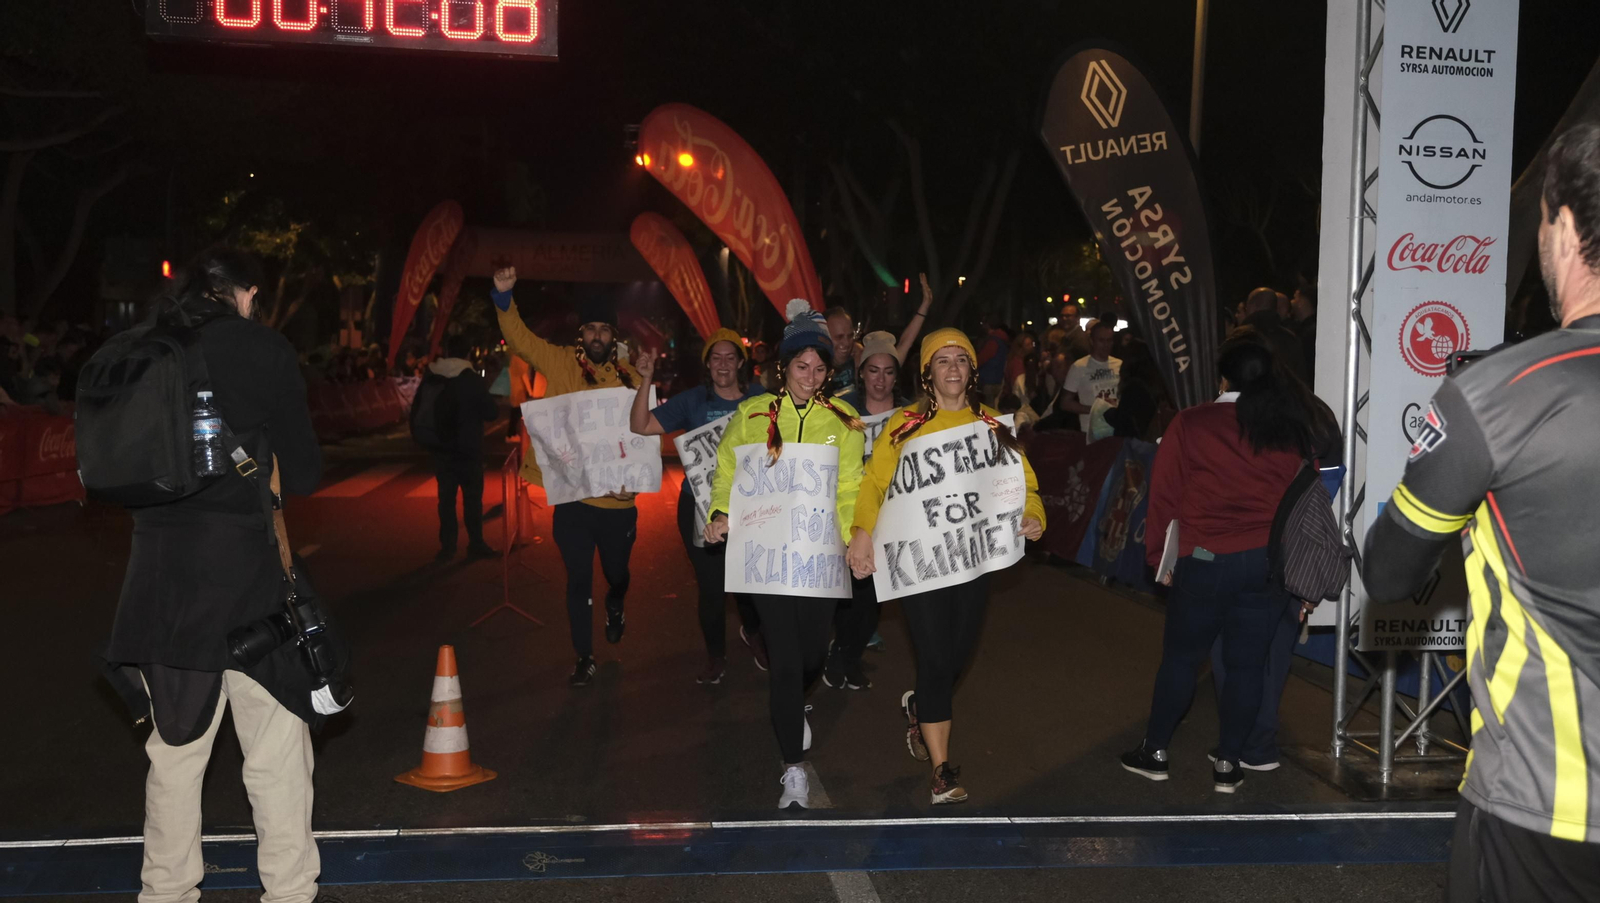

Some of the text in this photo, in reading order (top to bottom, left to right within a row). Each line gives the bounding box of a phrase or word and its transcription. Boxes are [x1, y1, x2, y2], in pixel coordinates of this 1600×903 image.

[1400, 44, 1496, 64] RENAULT
[1400, 62, 1494, 78] SYRSA AUTOMOCION
[1398, 144, 1486, 160] NISSAN
[1405, 193, 1482, 206] andalmotor.es
[1387, 232, 1499, 274] Coca-Cola
[923, 491, 983, 529] FÖR
[1374, 619, 1466, 633] RENAULT
[1374, 636, 1465, 646] SYRSA AUTOMOCION
